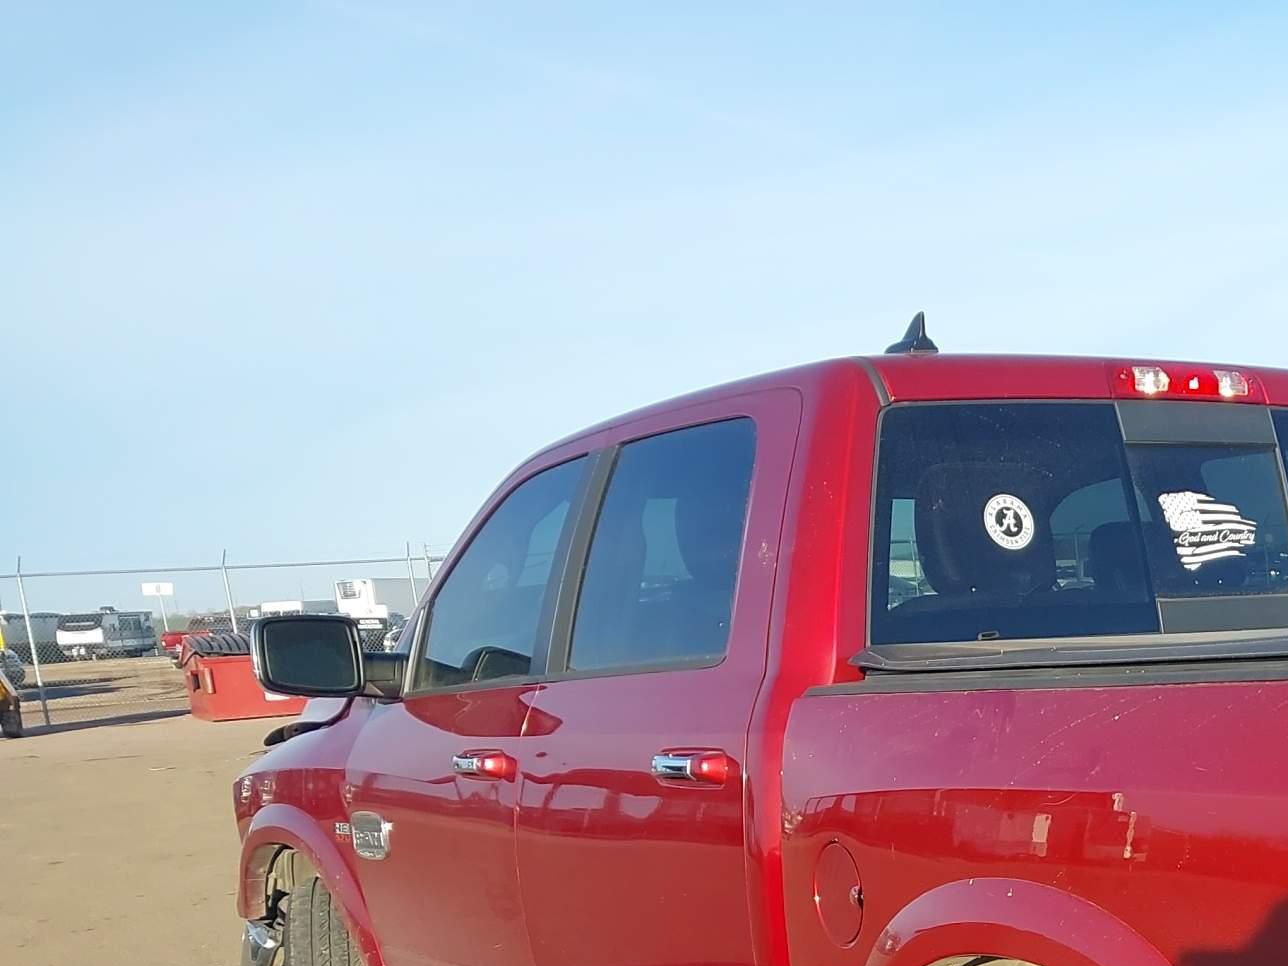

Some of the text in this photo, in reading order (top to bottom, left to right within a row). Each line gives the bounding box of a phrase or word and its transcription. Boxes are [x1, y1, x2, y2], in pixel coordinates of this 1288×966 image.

[988, 498, 1028, 519] ALABAMA
[996, 508, 1019, 532] A
[1178, 529, 1256, 546] God and Country
